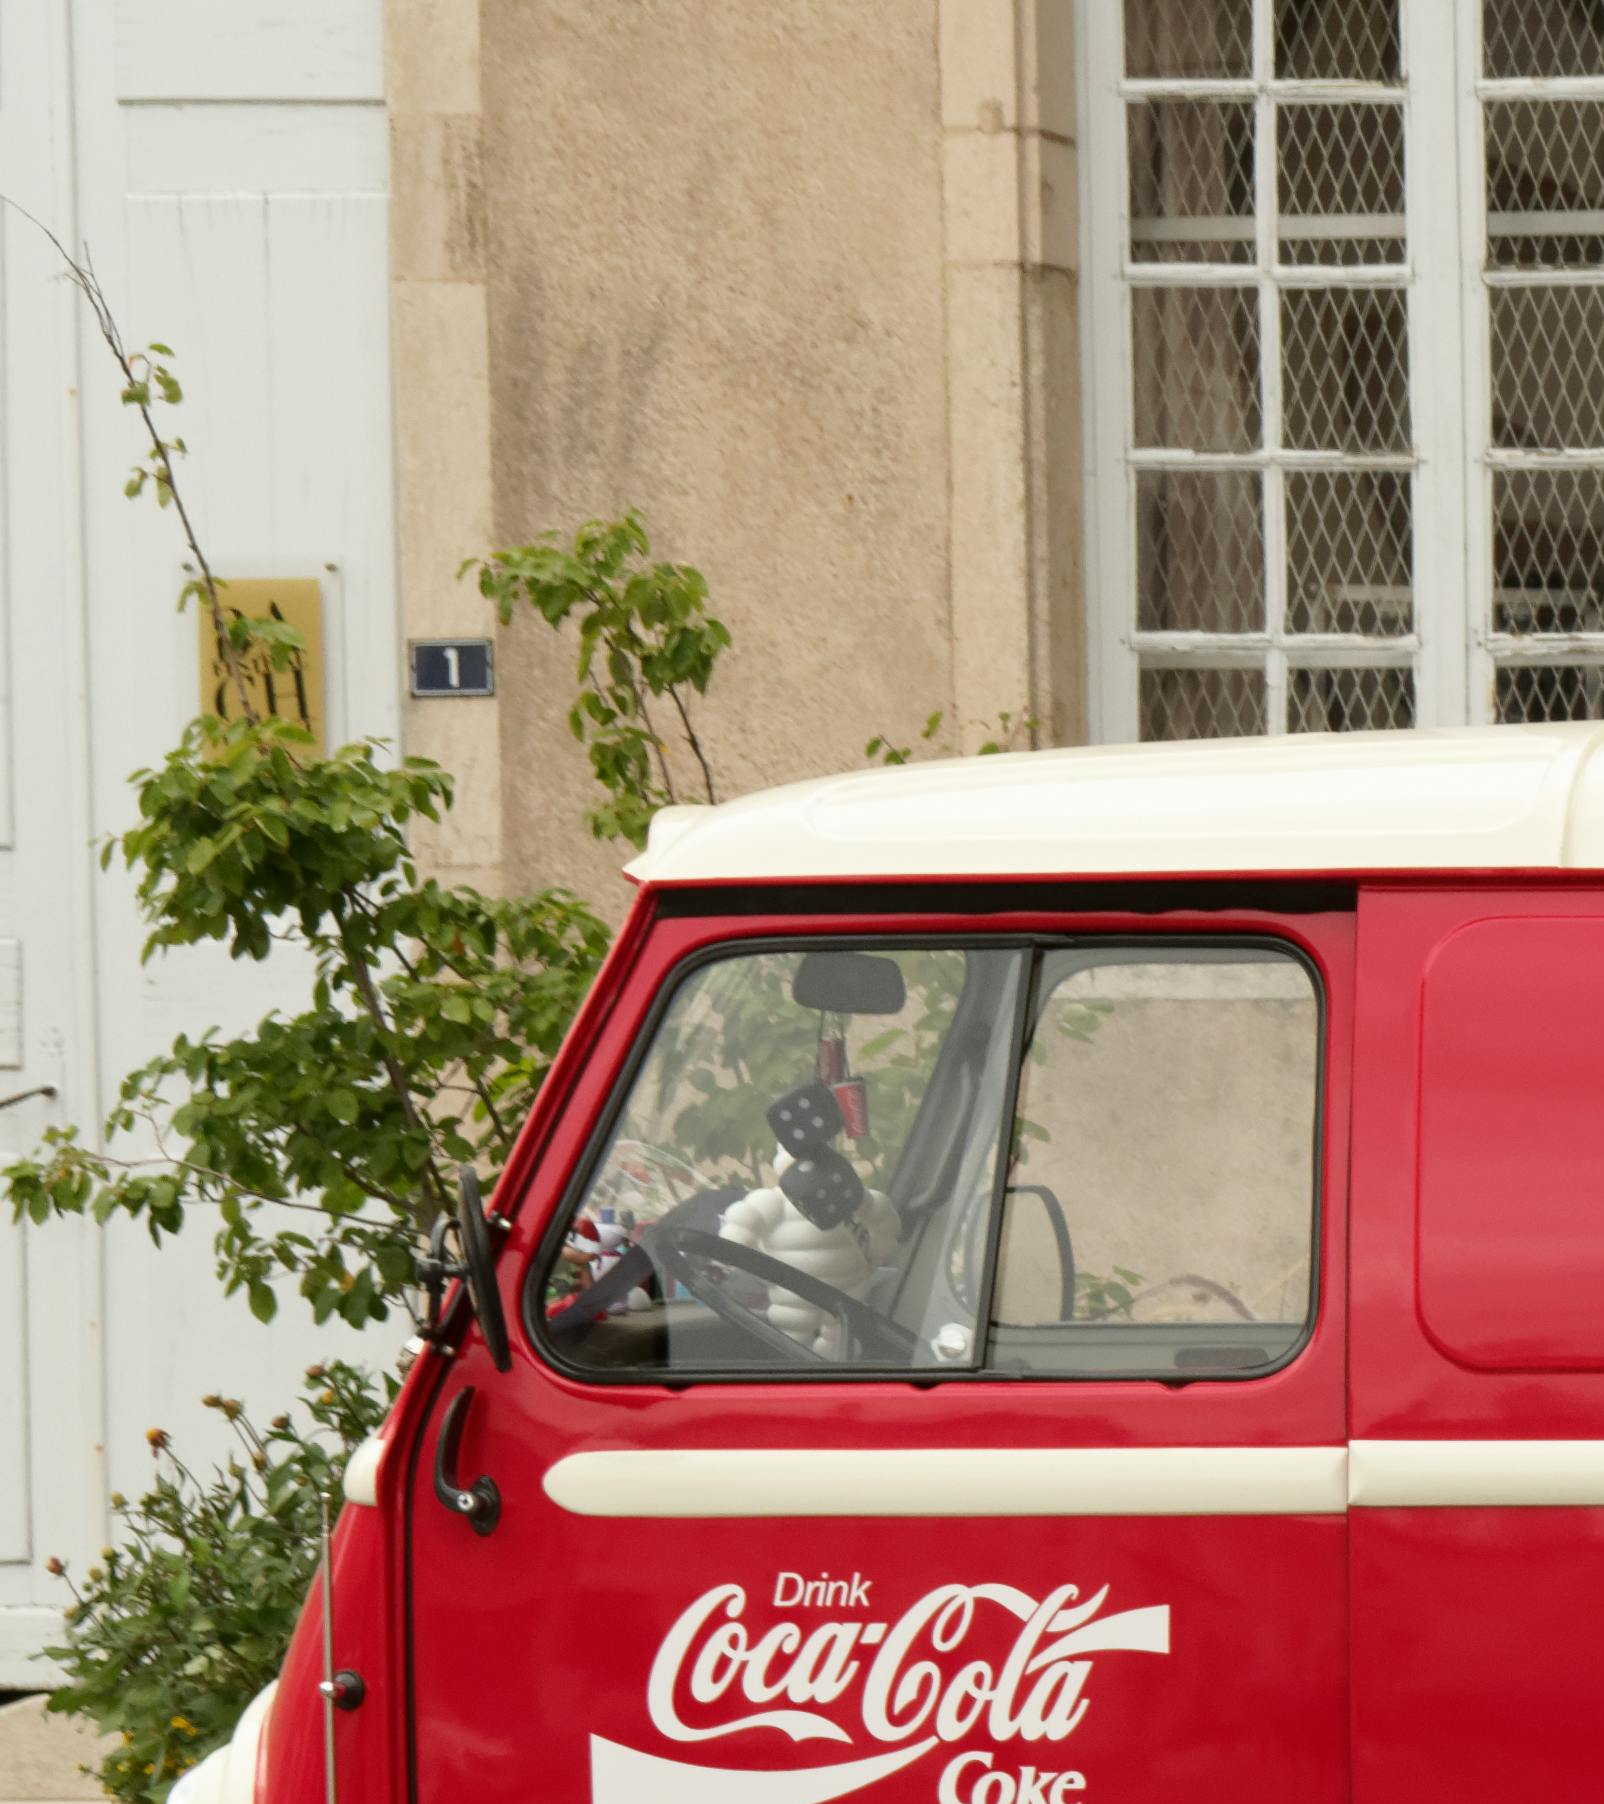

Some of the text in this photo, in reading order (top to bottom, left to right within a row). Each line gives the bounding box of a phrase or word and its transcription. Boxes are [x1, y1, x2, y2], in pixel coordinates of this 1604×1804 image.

[442, 646, 461, 690] 1
[773, 1572, 872, 1607] Drink
[647, 1583, 1109, 1744] Coca-Cola
